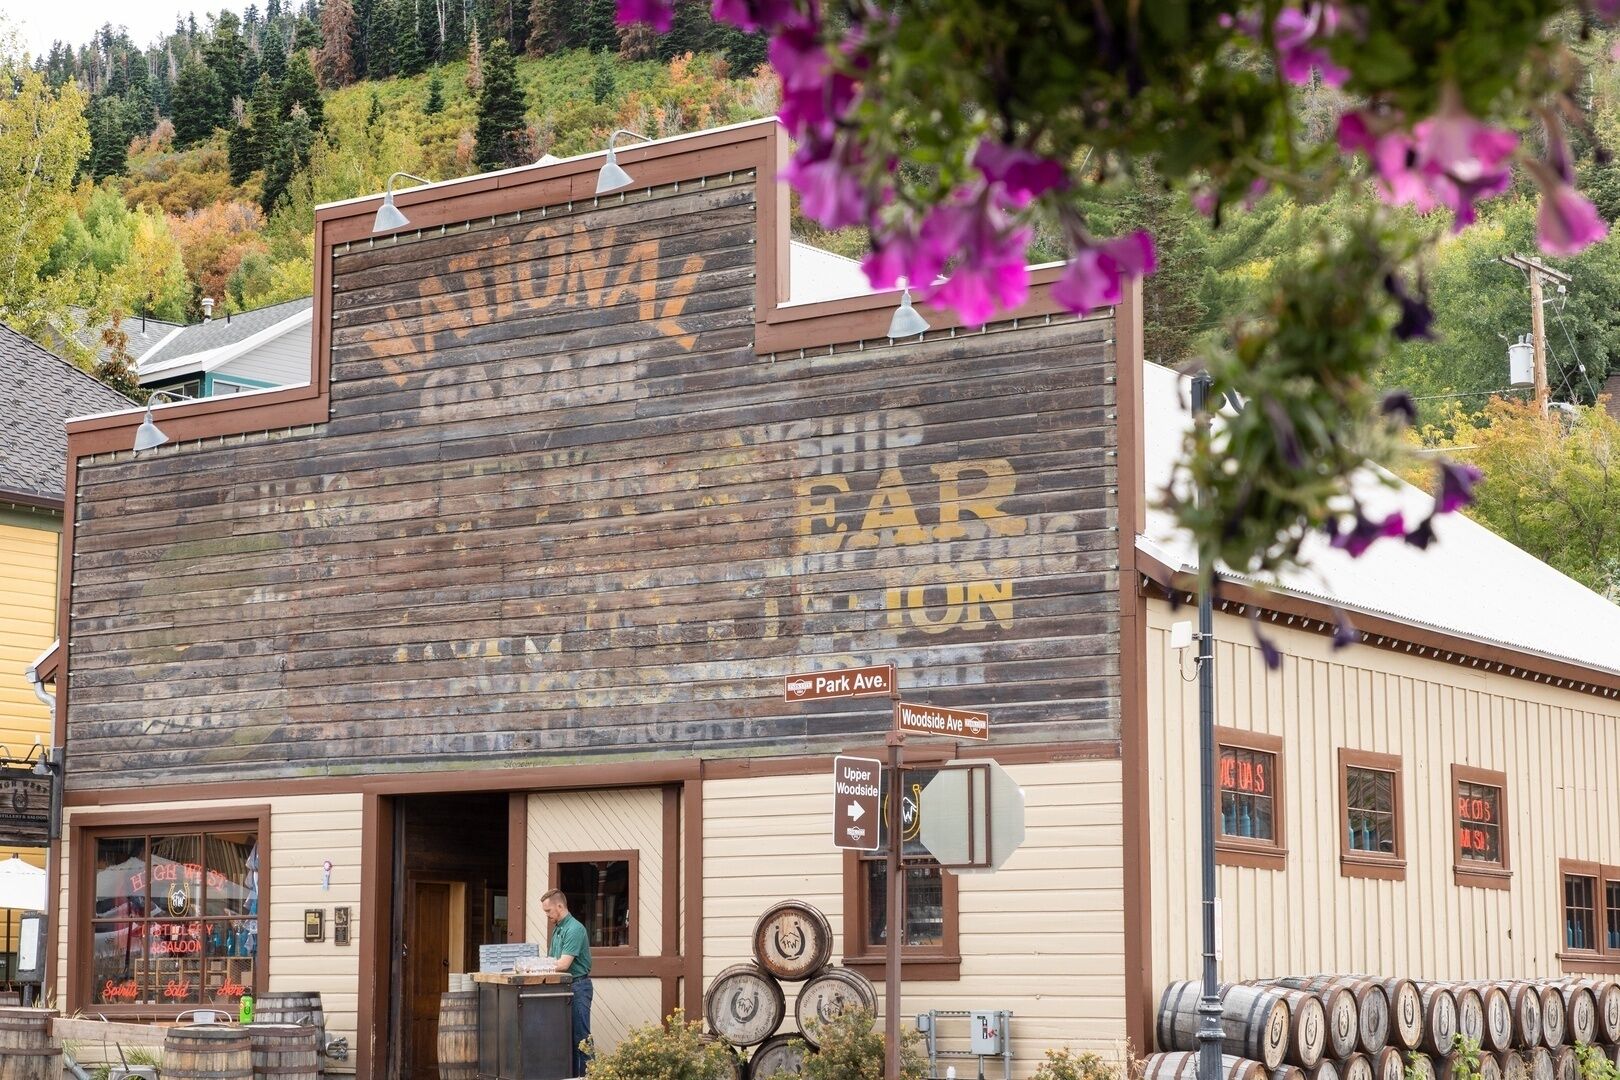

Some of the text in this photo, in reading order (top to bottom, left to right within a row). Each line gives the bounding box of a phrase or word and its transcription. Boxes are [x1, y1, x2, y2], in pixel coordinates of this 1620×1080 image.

[361, 223, 706, 386] NATIONAL
[816, 675, 850, 694] Park
[853, 673, 887, 690] Ave.
[902, 708, 945, 730] Woodside
[946, 714, 963, 731] Ave
[844, 766, 871, 782] Upper
[836, 781, 878, 797] Woodside
[130, 864, 177, 893] HGH
[102, 979, 139, 1000] Spirits
[163, 979, 190, 998] Sold
[216, 976, 247, 997] Here
